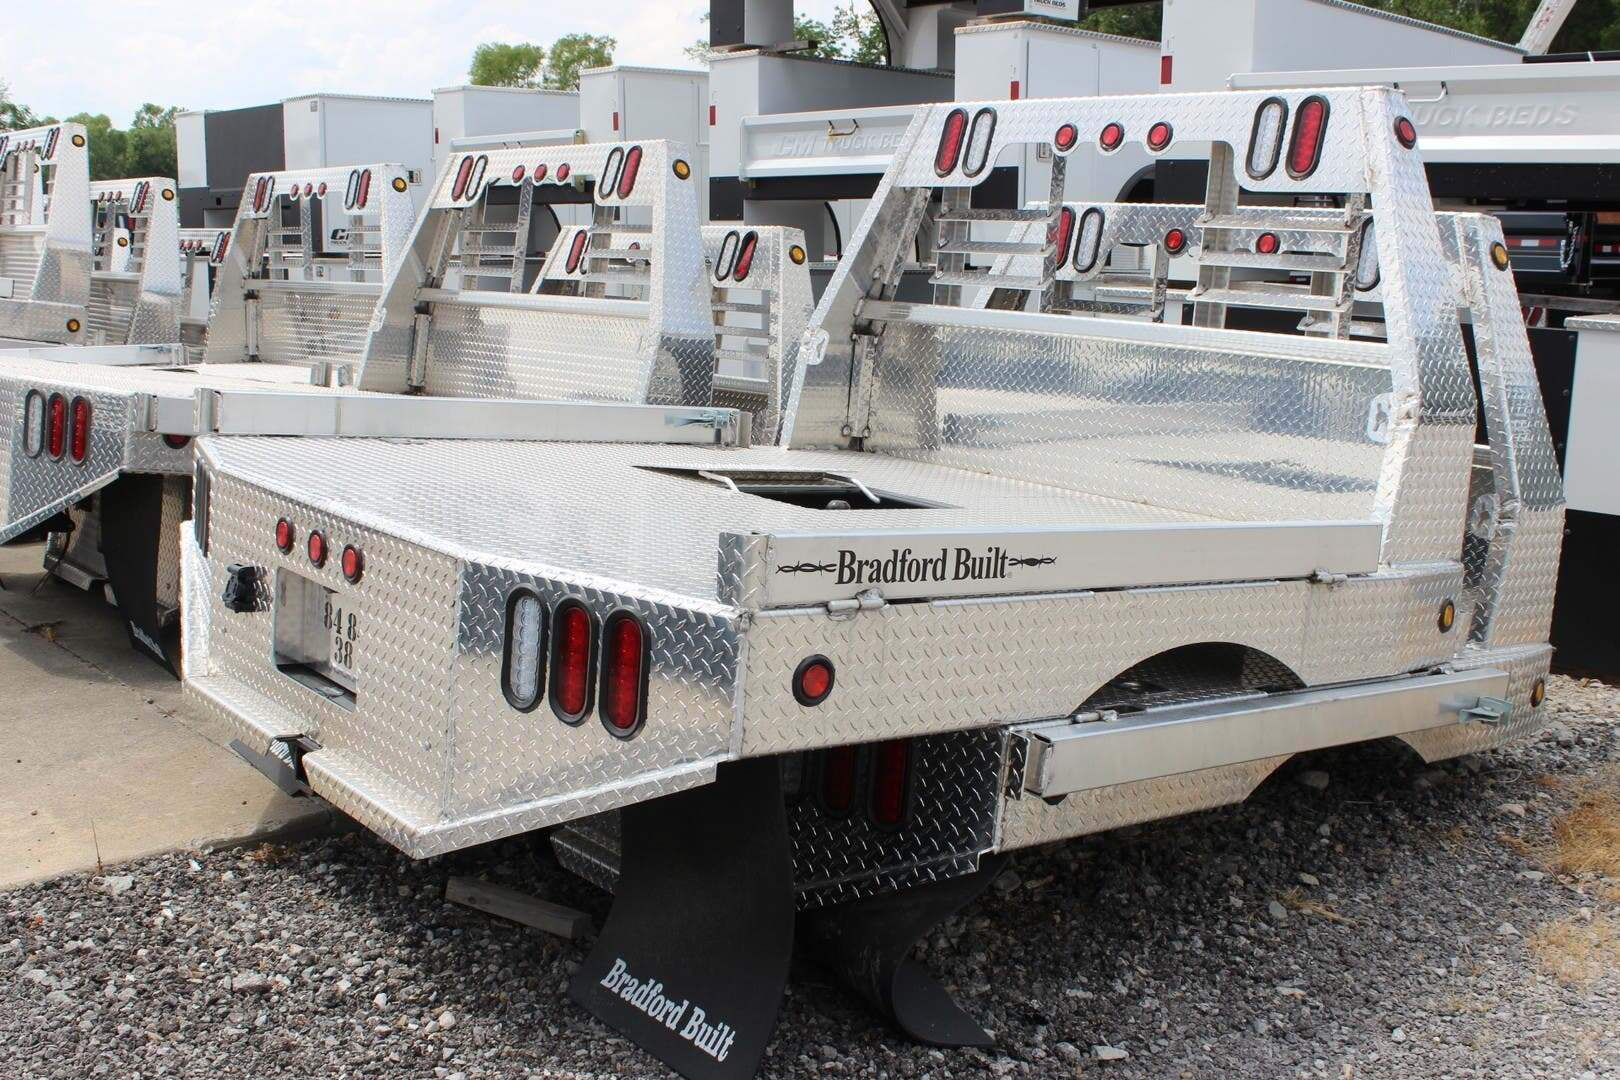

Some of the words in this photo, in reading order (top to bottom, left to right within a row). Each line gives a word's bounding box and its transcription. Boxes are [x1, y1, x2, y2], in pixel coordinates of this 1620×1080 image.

[1414, 104, 1477, 127] UCK
[1486, 103, 1579, 127] BEDS
[823, 134, 878, 152] TRUCK
[835, 548, 948, 585] Bradford
[951, 546, 1009, 581] Built
[333, 636, 353, 670] 38
[600, 957, 690, 1031] Bradford
[679, 1005, 736, 1062] Built
